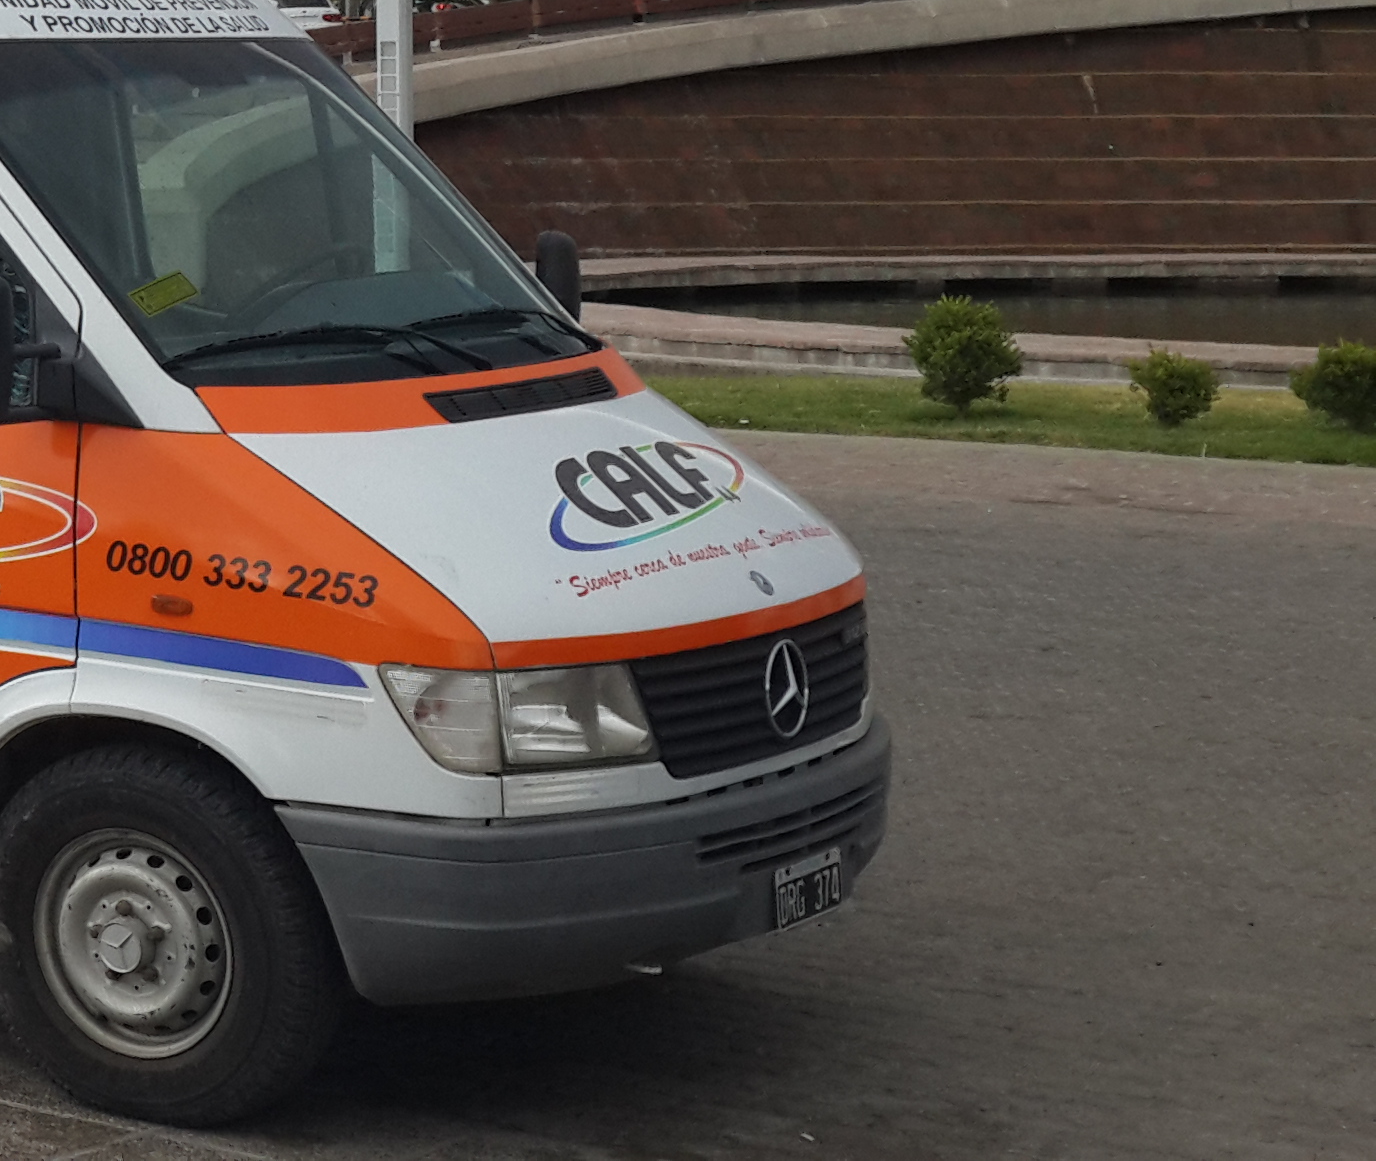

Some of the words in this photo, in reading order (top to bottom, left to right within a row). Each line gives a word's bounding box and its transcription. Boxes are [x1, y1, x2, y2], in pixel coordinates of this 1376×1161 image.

[20, 14, 38, 32] Y
[41, 12, 174, 34] PROMOCIÓN
[170, 17, 202, 33] DE
[196, 17, 226, 33] LA
[219, 15, 270, 32] SALUD
[555, 441, 715, 528] CALF
[106, 540, 192, 581] 0800
[203, 553, 271, 593] 333
[282, 564, 378, 608] 2253
[568, 567, 633, 598] Siempre
[814, 866, 839, 910] 374
